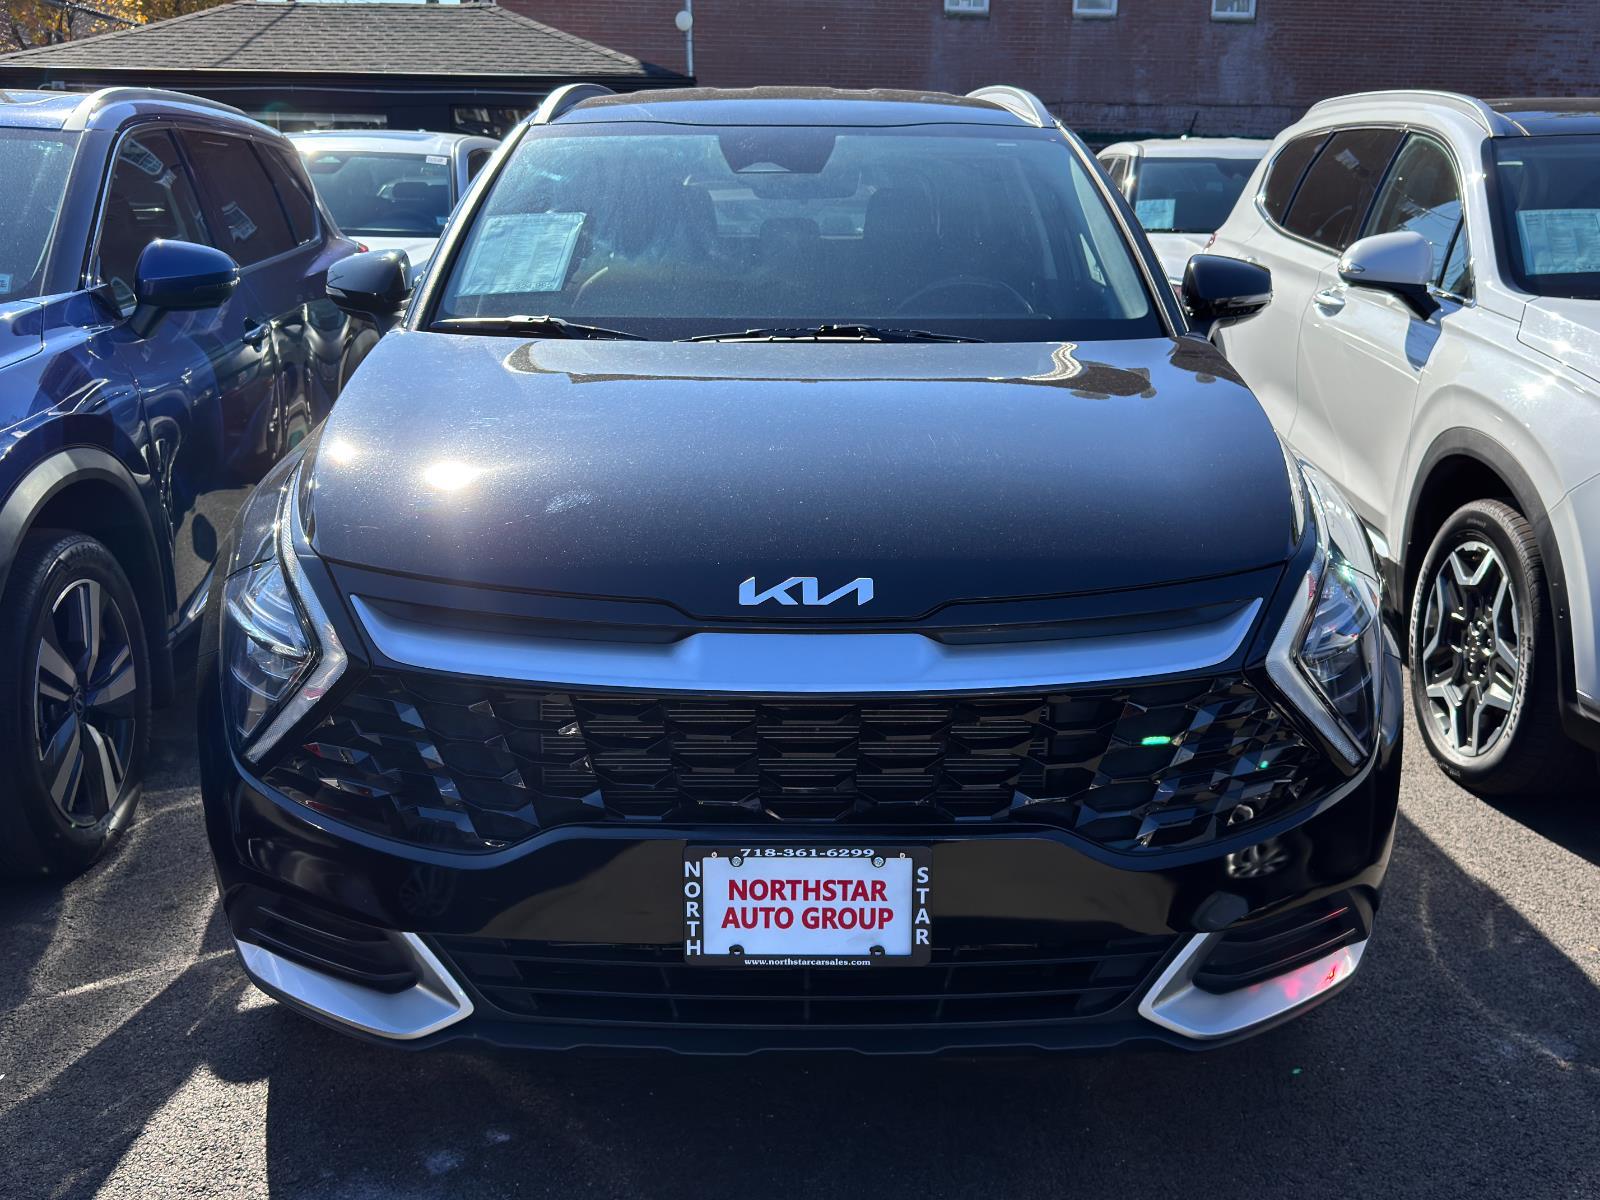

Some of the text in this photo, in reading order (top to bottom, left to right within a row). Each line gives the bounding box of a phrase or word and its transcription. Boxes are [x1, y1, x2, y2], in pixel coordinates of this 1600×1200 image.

[738, 576, 874, 606] KIA
[740, 848, 875, 857] 718-361-6299
[728, 879, 888, 902] NORTHSTAR
[684, 861, 701, 956] NORTH
[915, 866, 930, 945] STAR
[721, 907, 894, 930] AUTO GROUP
[744, 958, 871, 967] www.northstarcarsales.com
